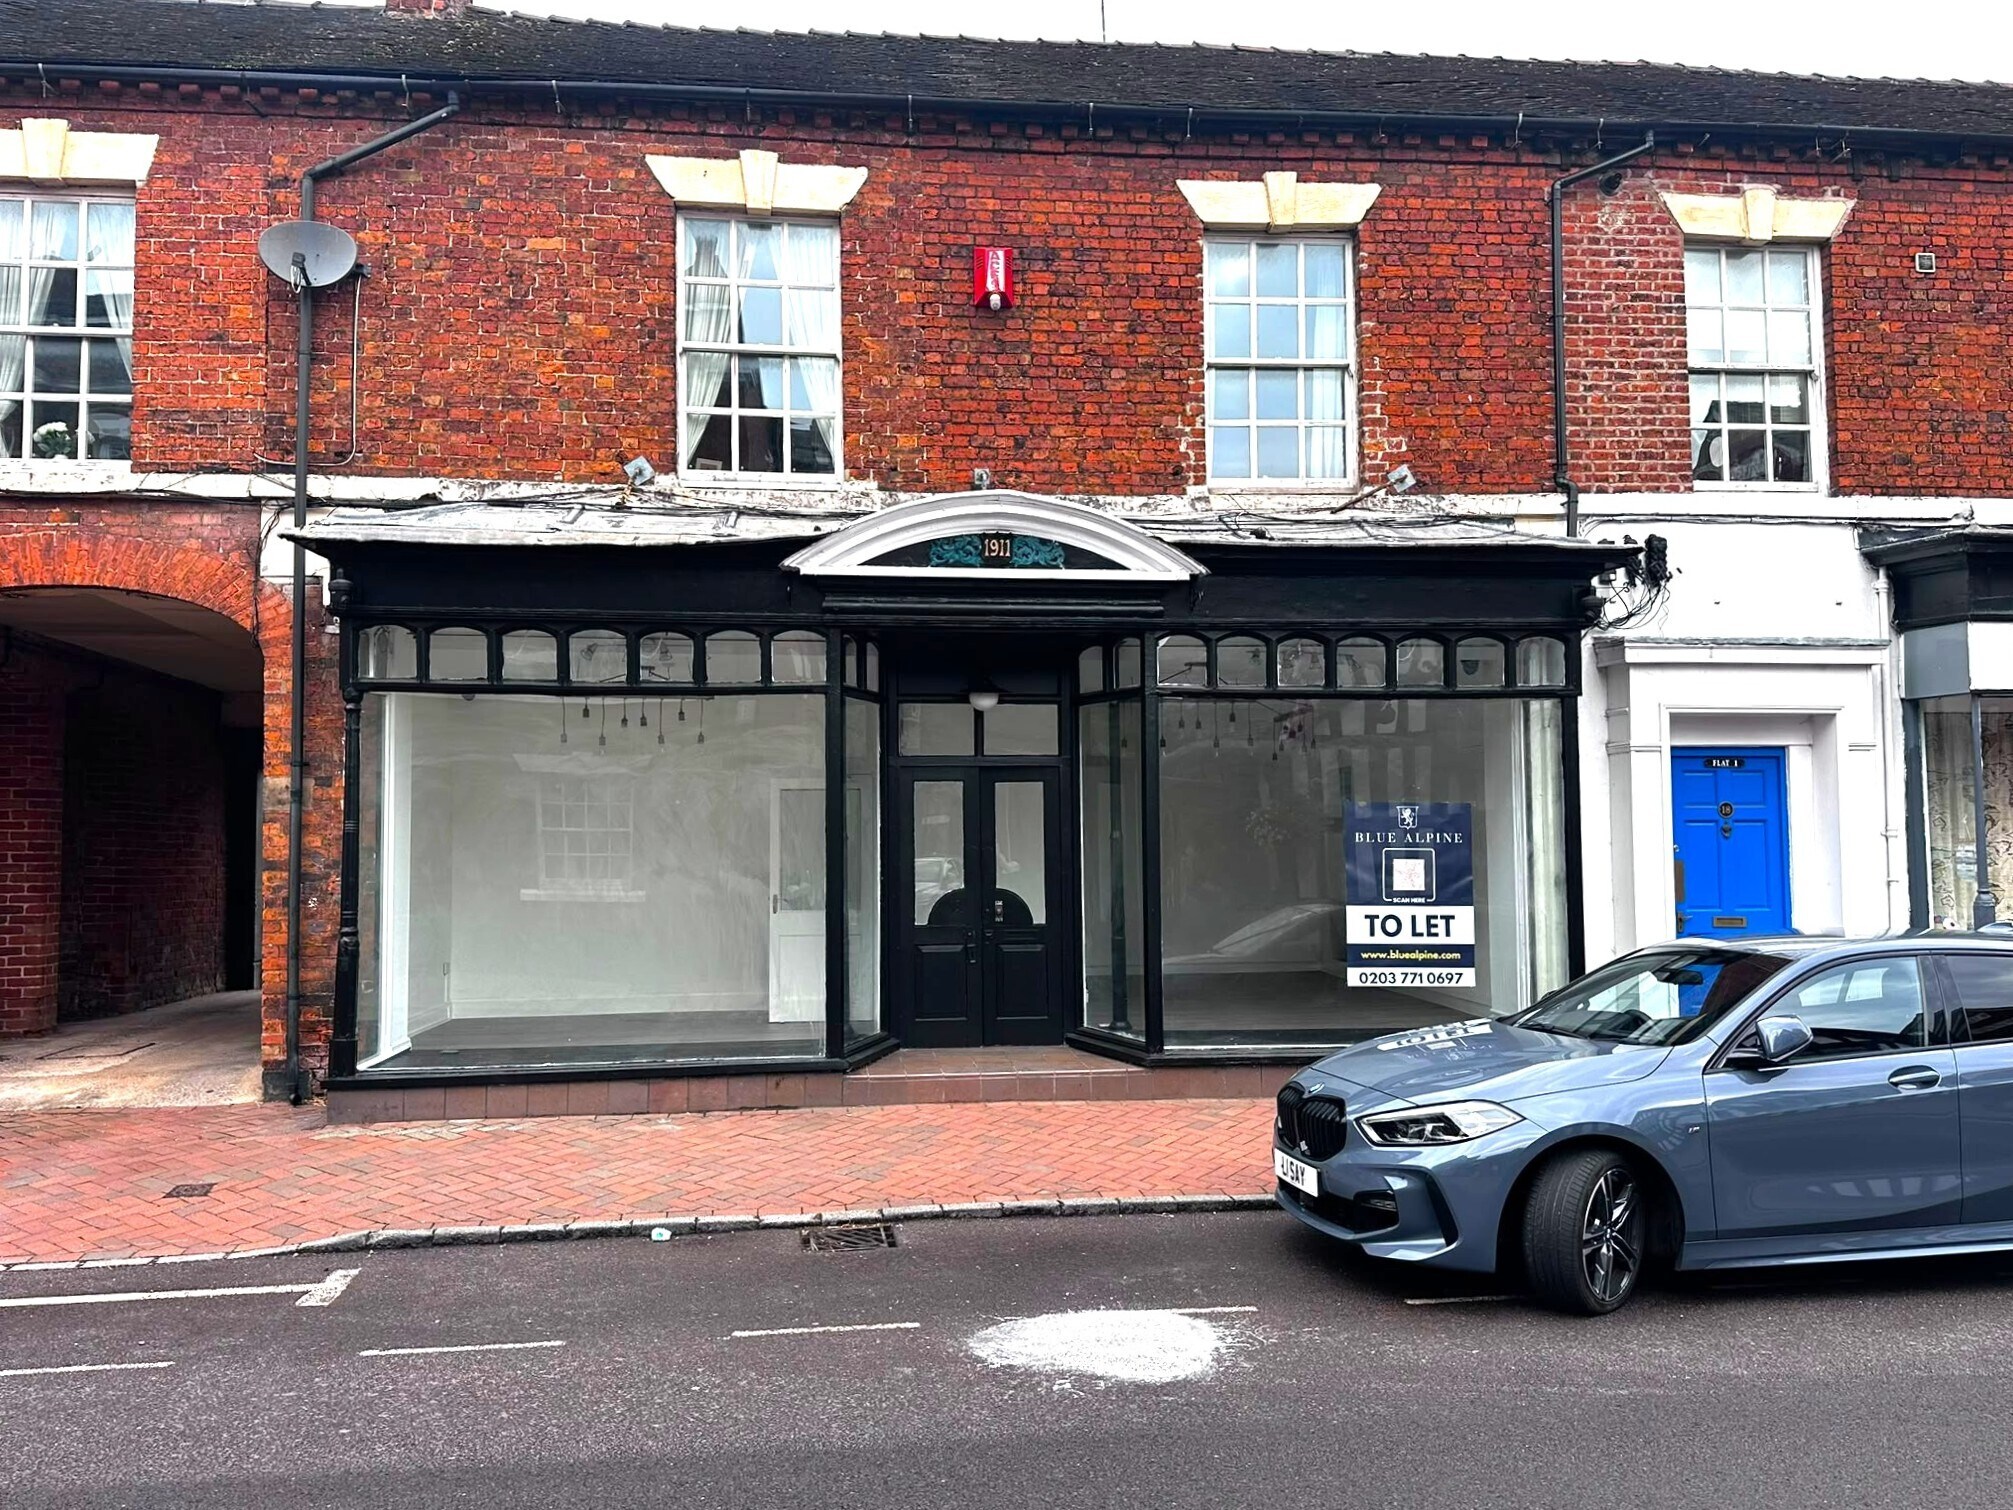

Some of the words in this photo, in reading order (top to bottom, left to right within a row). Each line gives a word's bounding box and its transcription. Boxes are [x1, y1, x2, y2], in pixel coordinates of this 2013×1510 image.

[984, 538, 1011, 557] 1911
[1712, 759, 1730, 767] FLAT
[1355, 832, 1396, 843] BLUE
[1404, 832, 1463, 843] ALPINE
[1364, 914, 1402, 937] TO
[1411, 914, 1455, 937] LET
[1360, 949, 1461, 961] www.bluealpine.com
[1359, 972, 1396, 984] 0203
[1400, 972, 1423, 984] 771
[1427, 972, 1463, 984] 0697
